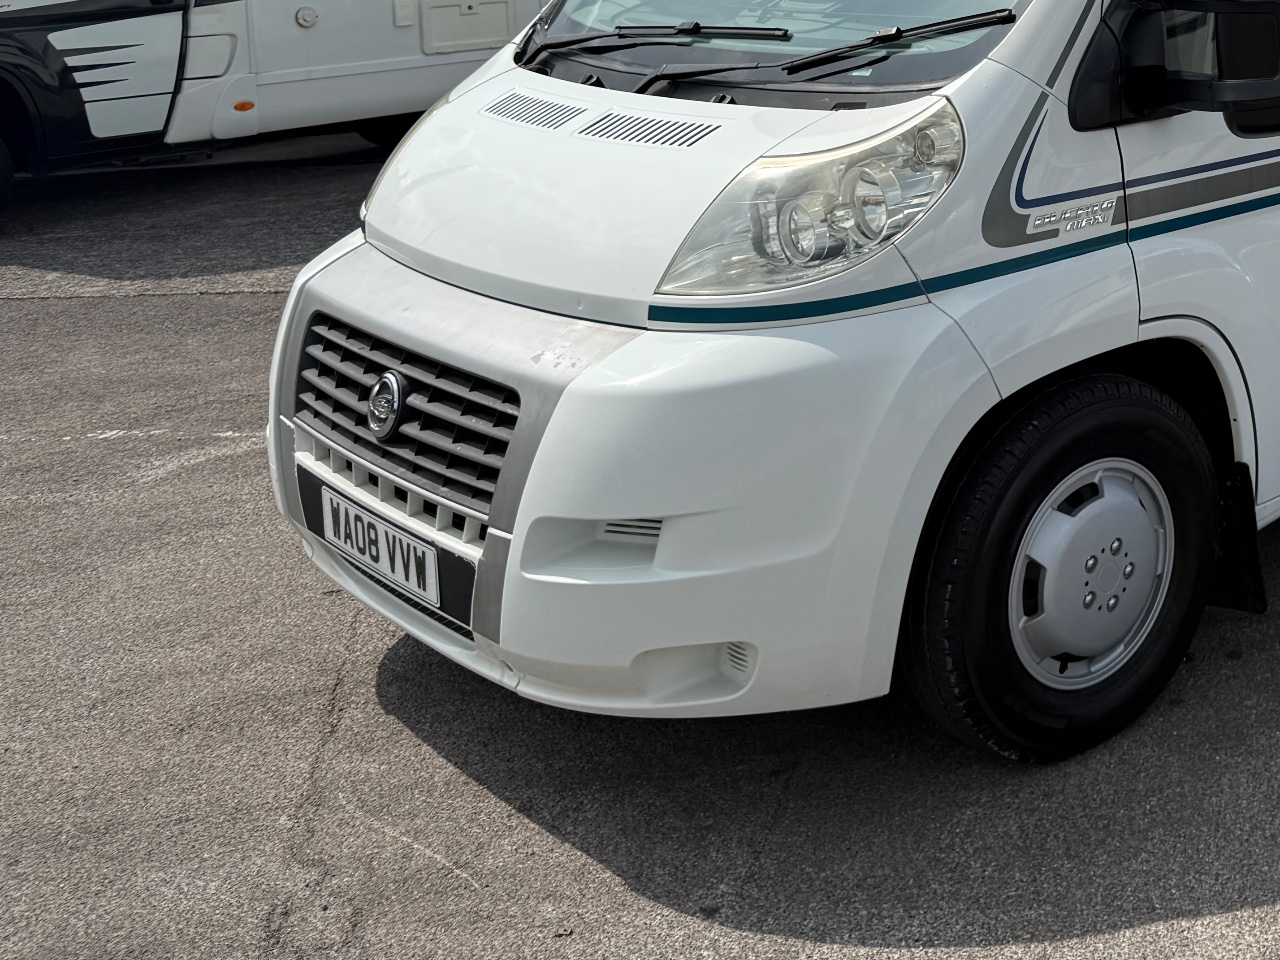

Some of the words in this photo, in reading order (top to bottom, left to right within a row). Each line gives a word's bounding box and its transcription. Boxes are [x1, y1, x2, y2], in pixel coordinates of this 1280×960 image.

[1033, 198, 1117, 229] DUCATO
[1065, 212, 1110, 232] MAXI
[329, 496, 380, 565] WA08
[384, 529, 427, 593] VVW
